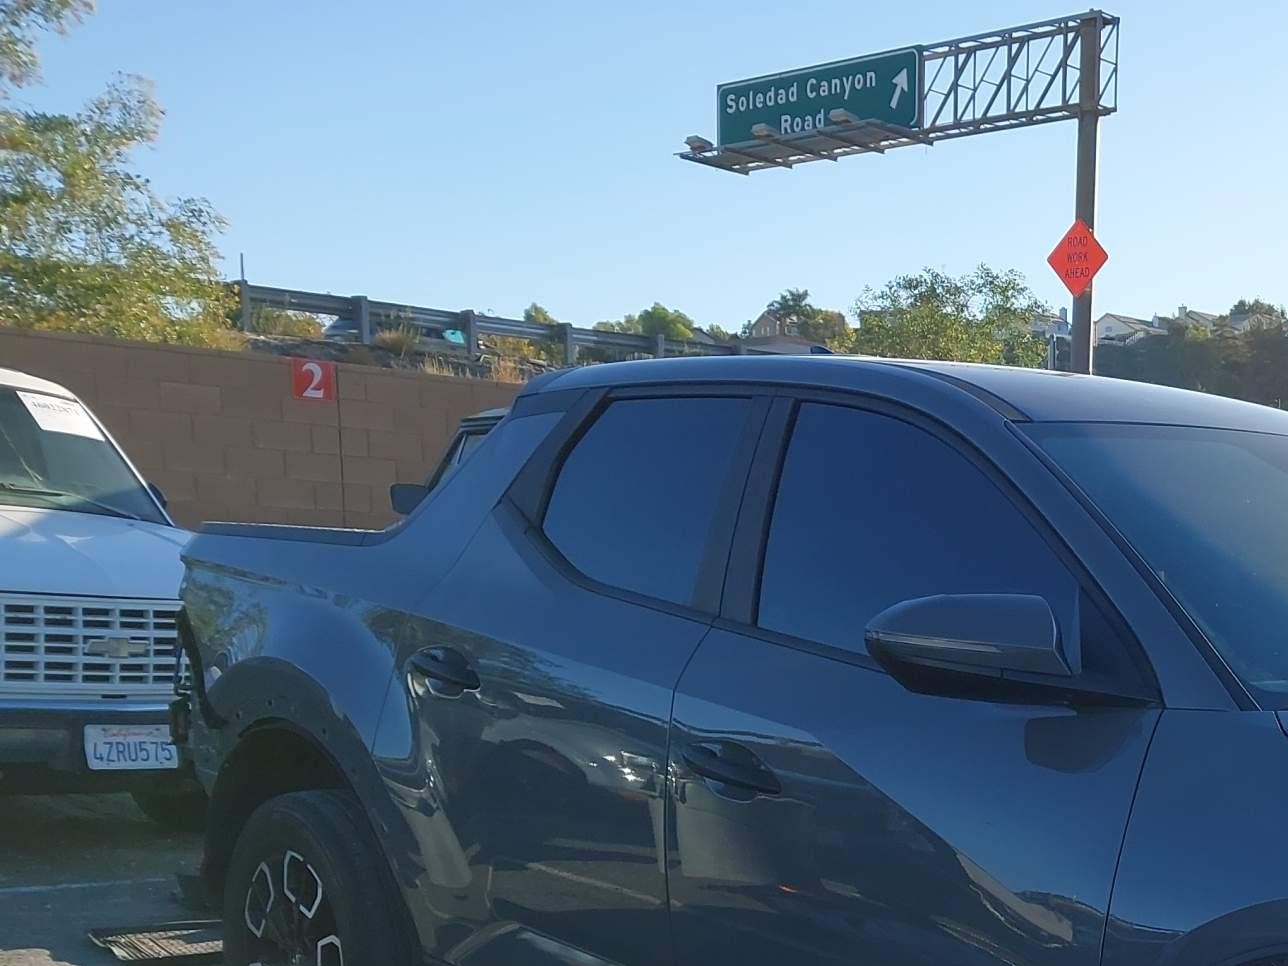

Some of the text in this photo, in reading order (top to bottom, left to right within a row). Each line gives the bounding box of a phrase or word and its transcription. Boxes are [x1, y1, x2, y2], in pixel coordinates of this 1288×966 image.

[726, 71, 876, 114] Soledad Canyon
[780, 108, 825, 134] Road
[1067, 236, 1088, 248] ROAD
[1066, 252, 1088, 263] WORK
[1065, 267, 1090, 279] AHEAD
[302, 362, 324, 398] 2
[93, 741, 174, 762] 4ZRU575
